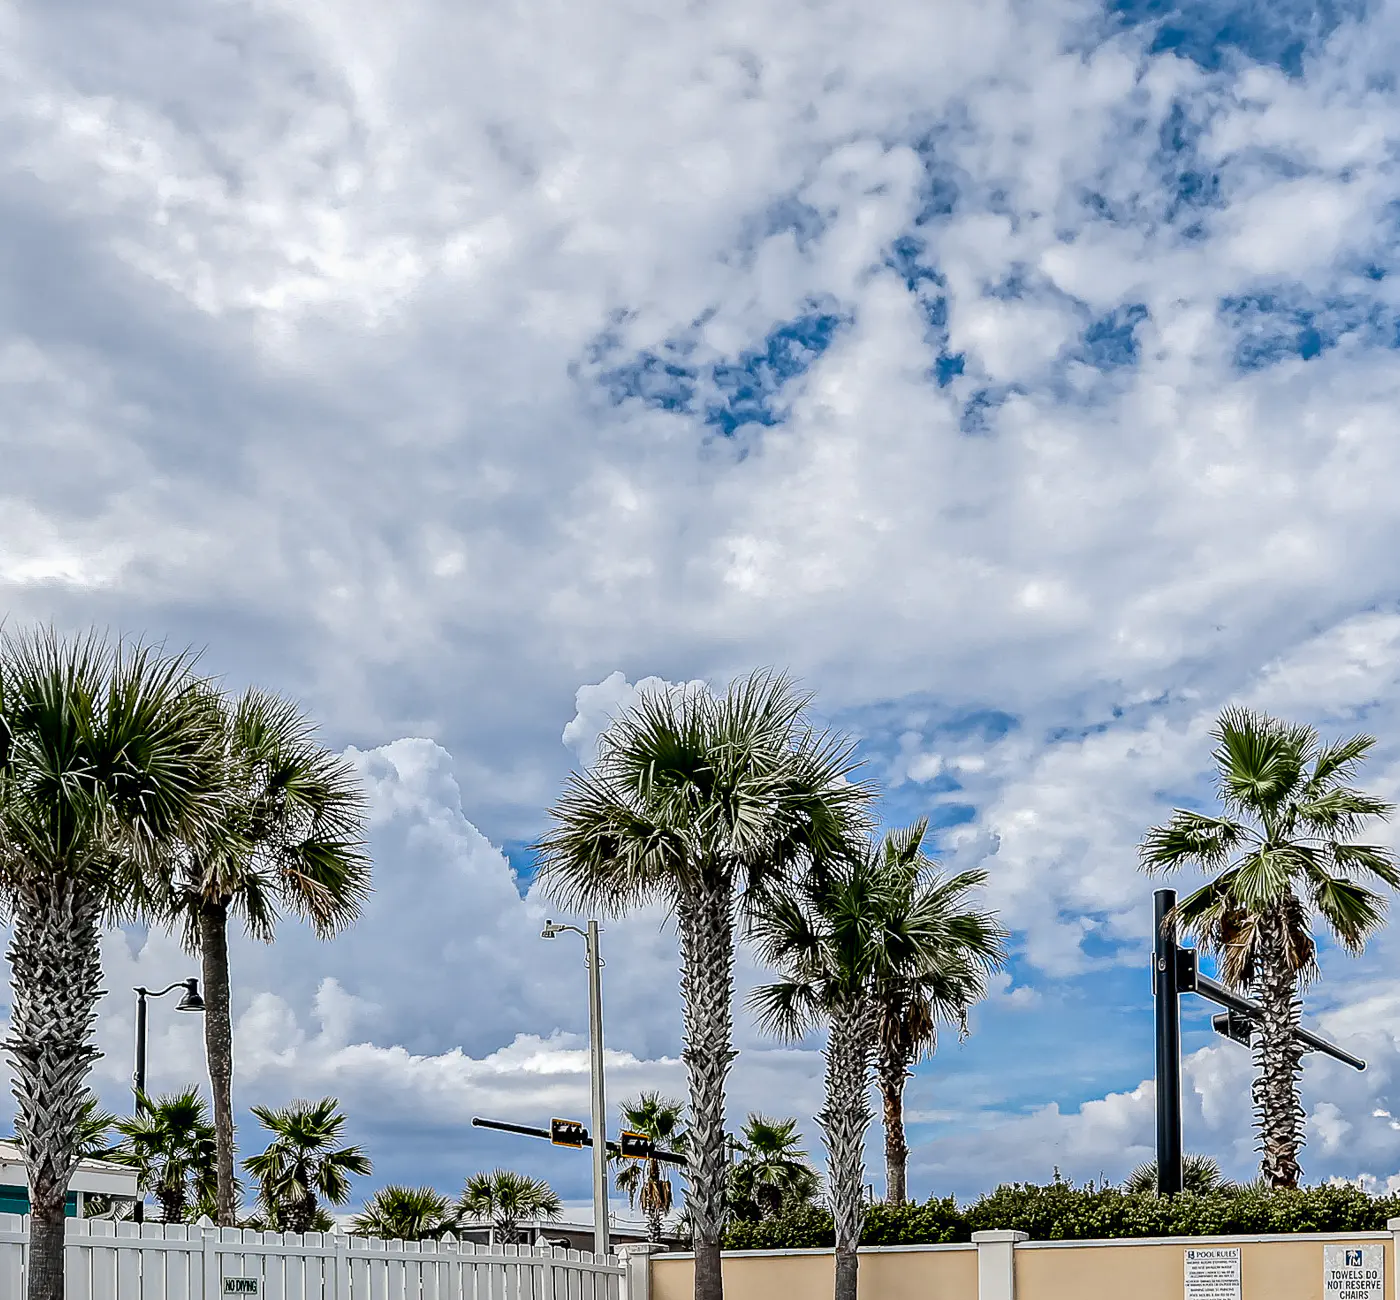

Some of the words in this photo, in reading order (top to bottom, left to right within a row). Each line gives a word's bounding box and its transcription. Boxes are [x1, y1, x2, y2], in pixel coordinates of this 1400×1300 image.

[1196, 1250, 1215, 1258] POOL
[1216, 1250, 1237, 1258] RULES
[1331, 1270, 1363, 1280] TOWELS
[1365, 1270, 1378, 1280] DO
[225, 1279, 235, 1292] NO
[236, 1279, 257, 1292] DIVING
[1327, 1280, 1343, 1290] NOT
[1346, 1280, 1381, 1290] RESERVE
[1339, 1290, 1369, 1300] CHAIRS
